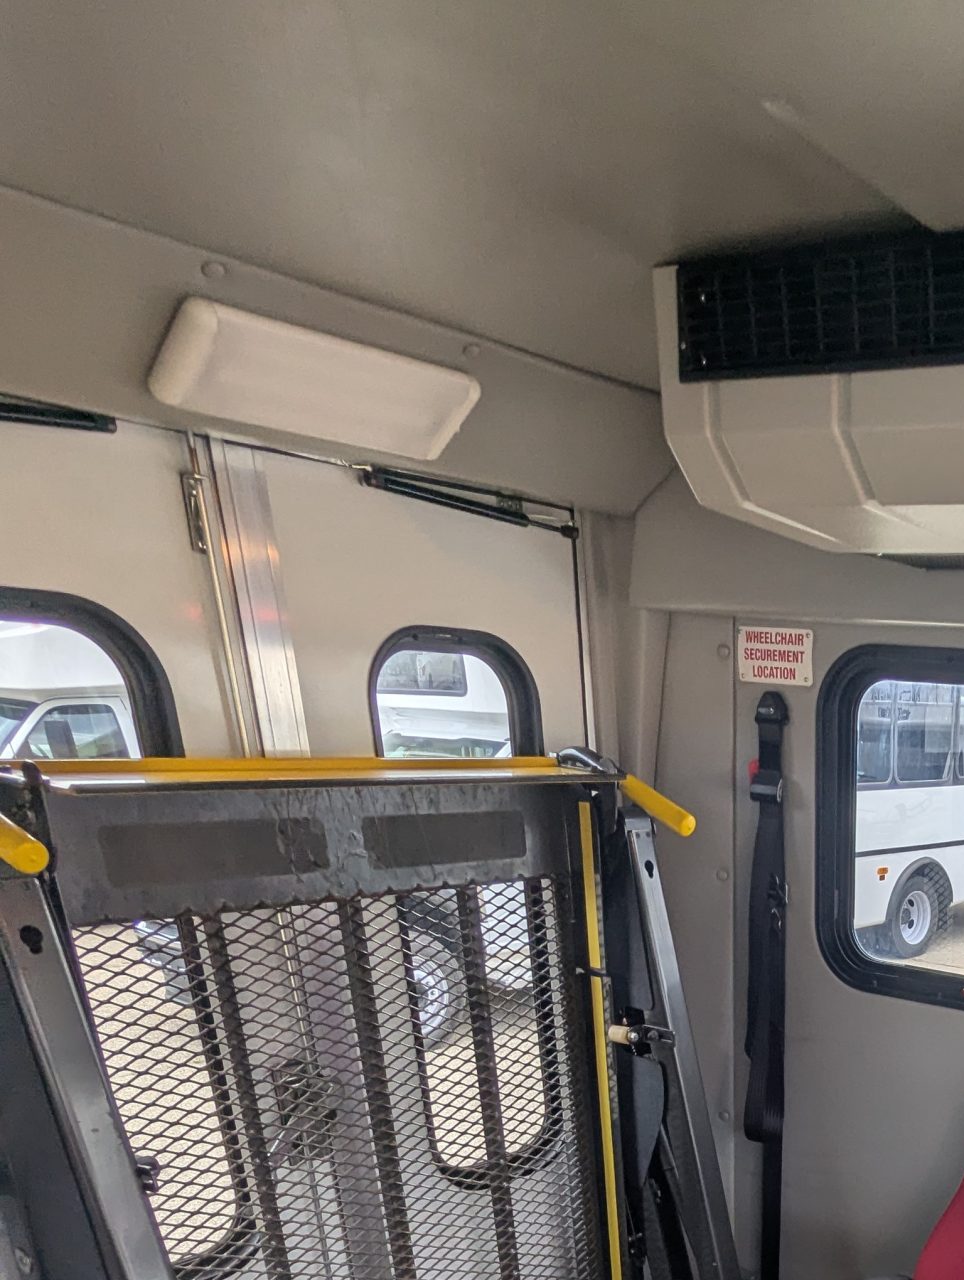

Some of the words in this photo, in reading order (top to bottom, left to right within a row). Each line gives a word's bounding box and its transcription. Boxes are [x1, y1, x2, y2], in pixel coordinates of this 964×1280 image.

[745, 630, 804, 646] WHEELCHAIR
[744, 647, 805, 664] SECUREMENT
[752, 665, 796, 681] LOCATION
